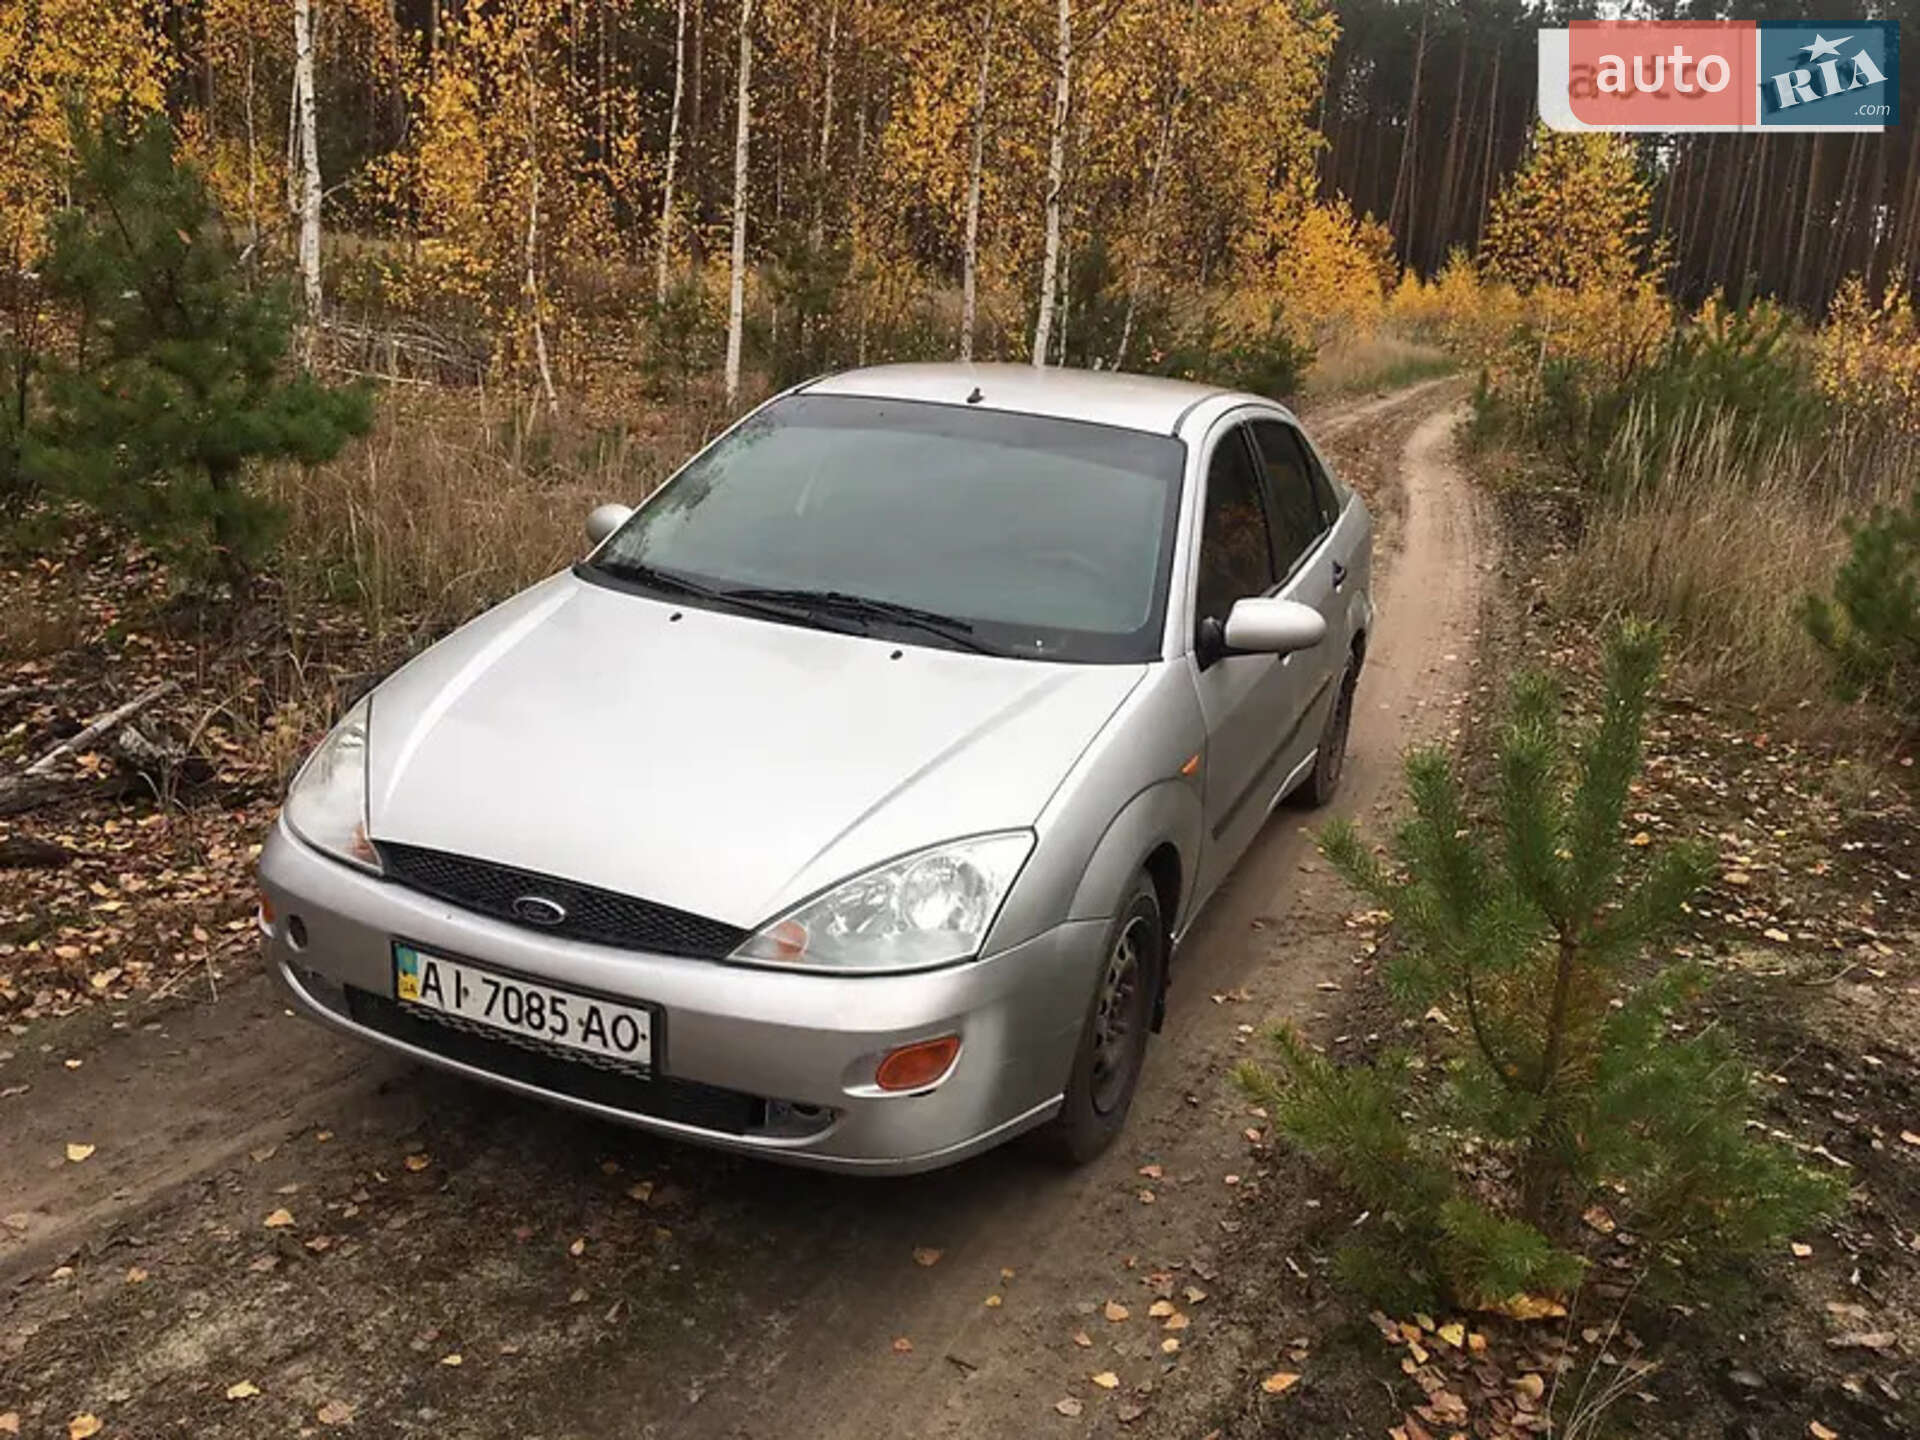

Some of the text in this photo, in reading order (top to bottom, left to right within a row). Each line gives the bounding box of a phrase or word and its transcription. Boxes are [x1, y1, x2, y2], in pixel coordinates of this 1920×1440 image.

[420, 961, 643, 1053] AI 7085 AO
